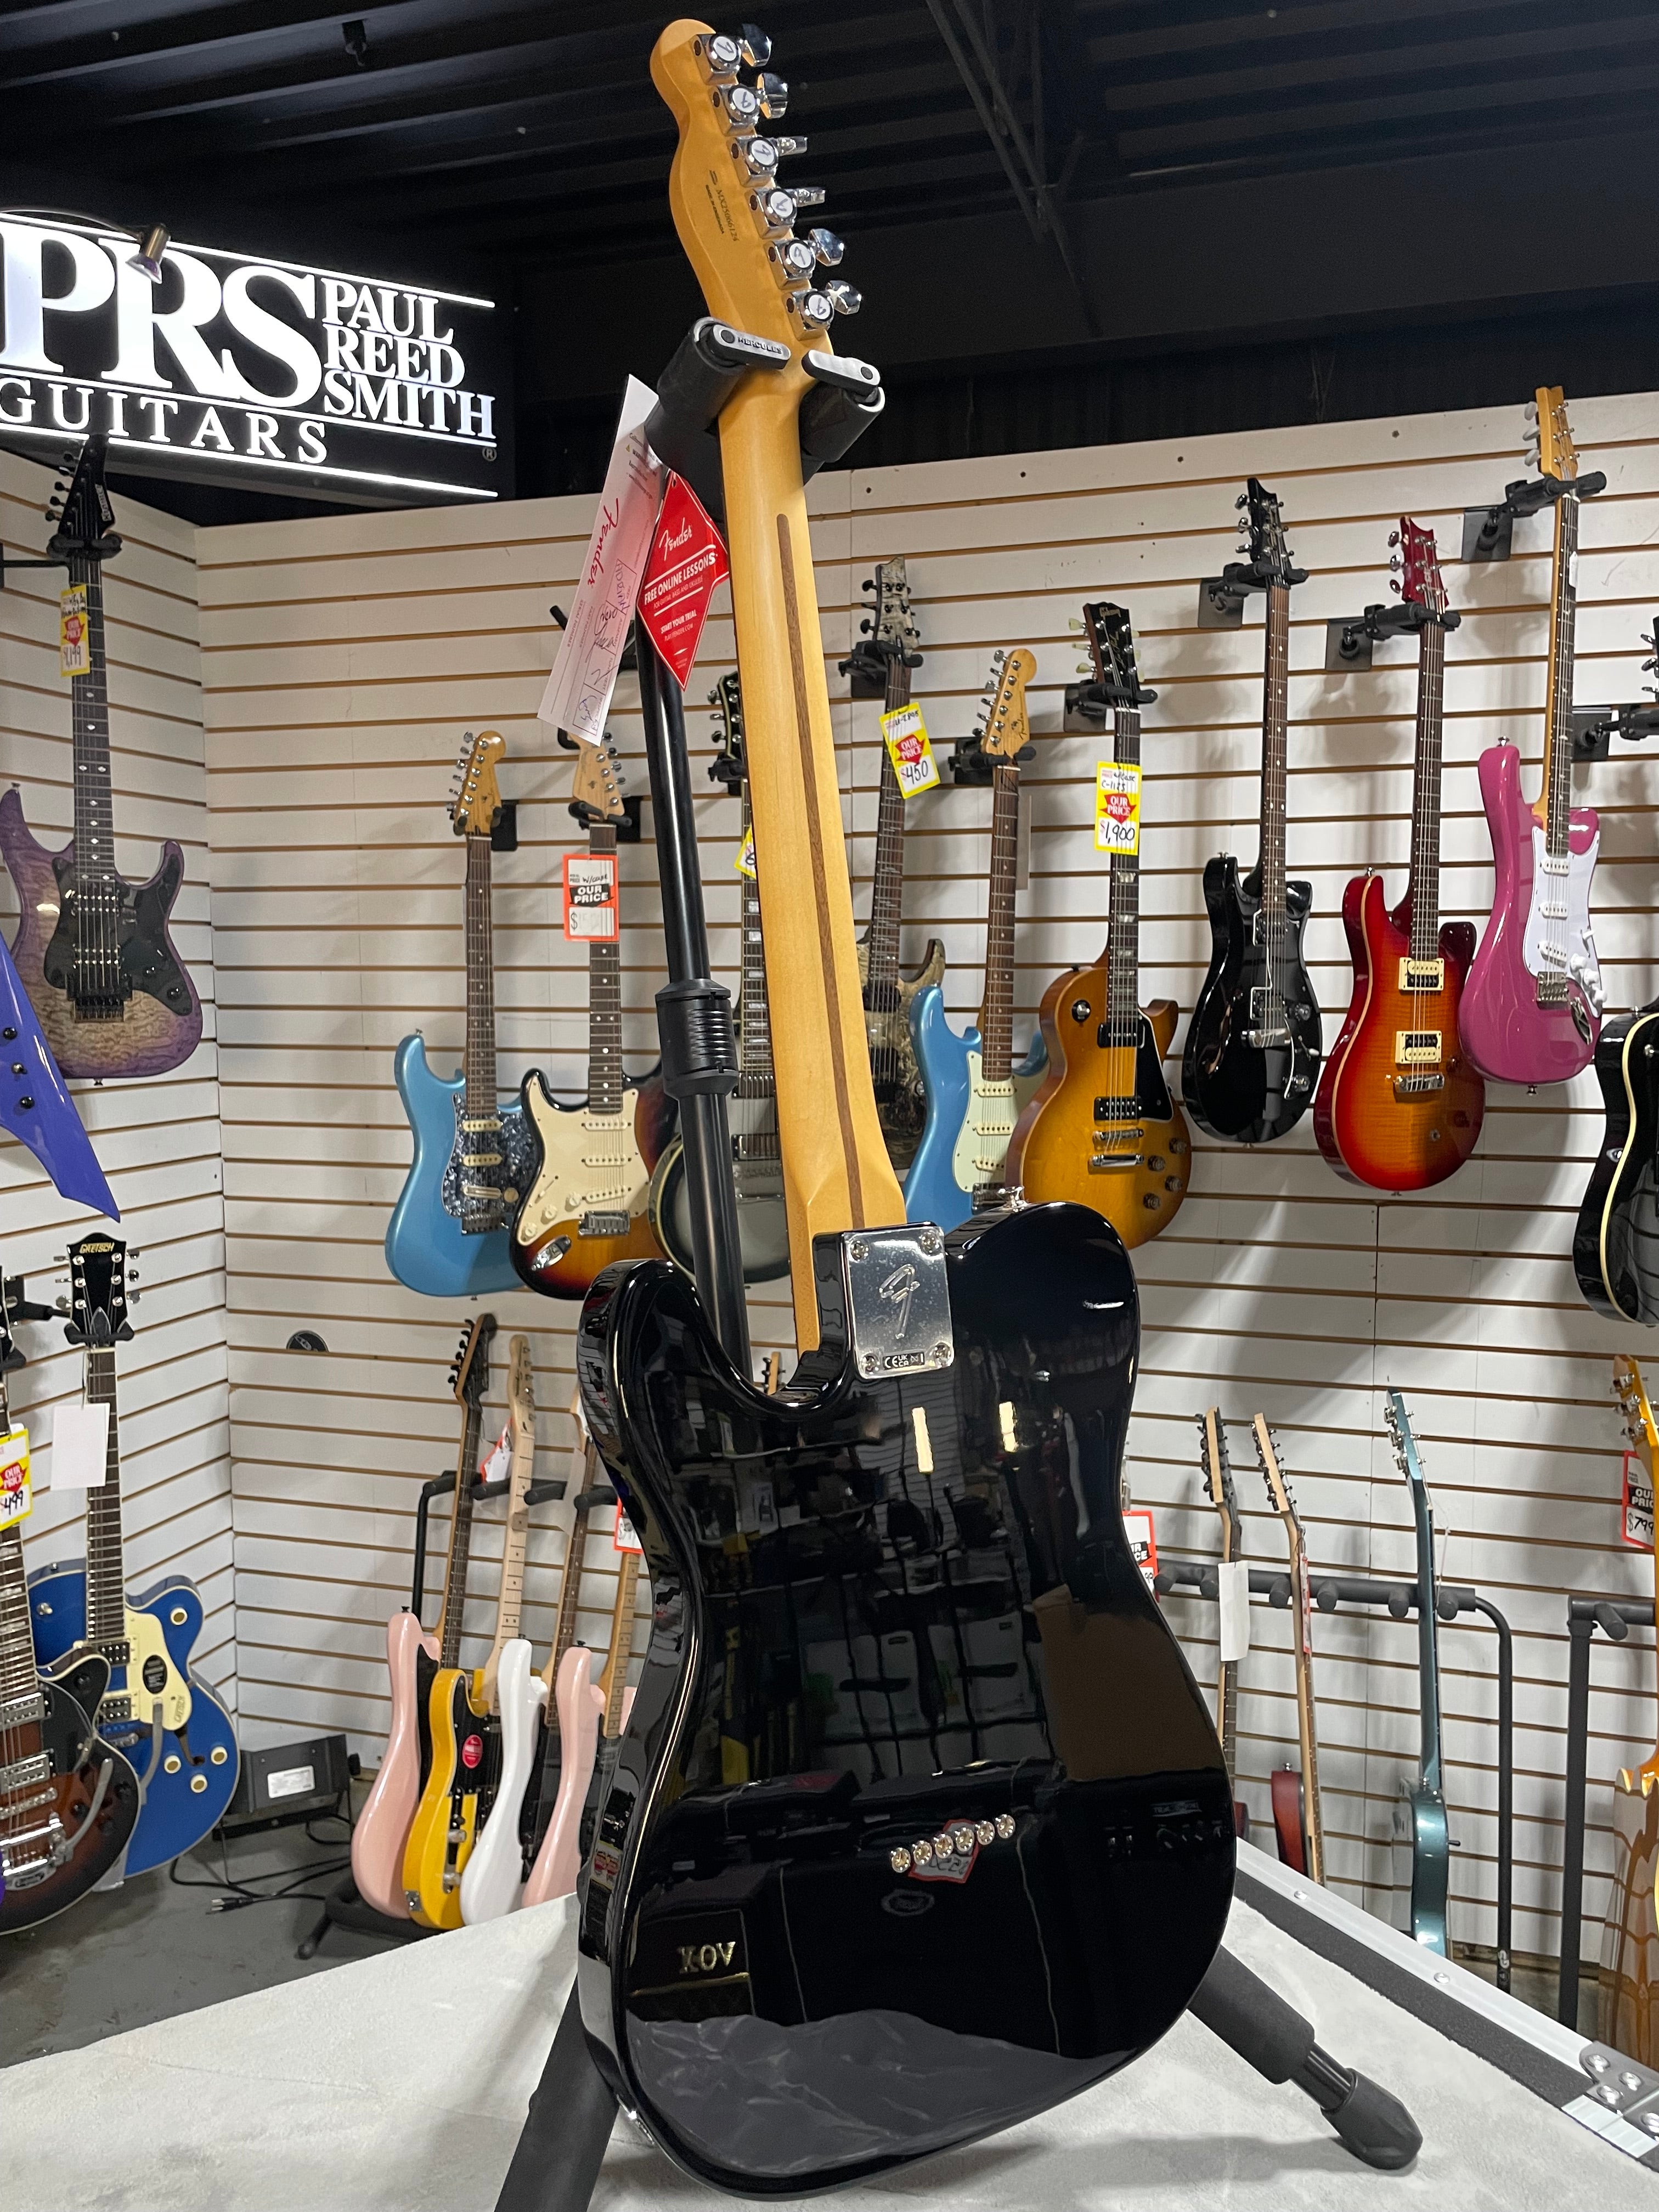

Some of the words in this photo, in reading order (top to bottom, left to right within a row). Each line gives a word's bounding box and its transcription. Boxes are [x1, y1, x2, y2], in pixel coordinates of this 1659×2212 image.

[0, 221, 323, 408] PRS
[321, 278, 454, 345] PAUL
[737, 337, 782, 354] HERCULES
[324, 323, 465, 388] REED
[324, 370, 496, 439] SMITH
[0, 378, 328, 465] GUITARS
[658, 517, 692, 561] Fender
[645, 591, 657, 605] FREE
[658, 571, 682, 596] ONLINE
[683, 552, 716, 582] LESSONS
[673, 617, 685, 627] YOUR
[685, 609, 697, 623] TRIAL
[900, 737, 918, 751] OUR
[901, 744, 923, 761] PRICE
[1110, 795, 1128, 806] OUR
[1107, 804, 1131, 817] PRICE
[574, 892, 608, 904] PRICE
[578, 885, 602, 895] OUR
[1631, 1496, 1654, 1509] PRIC
